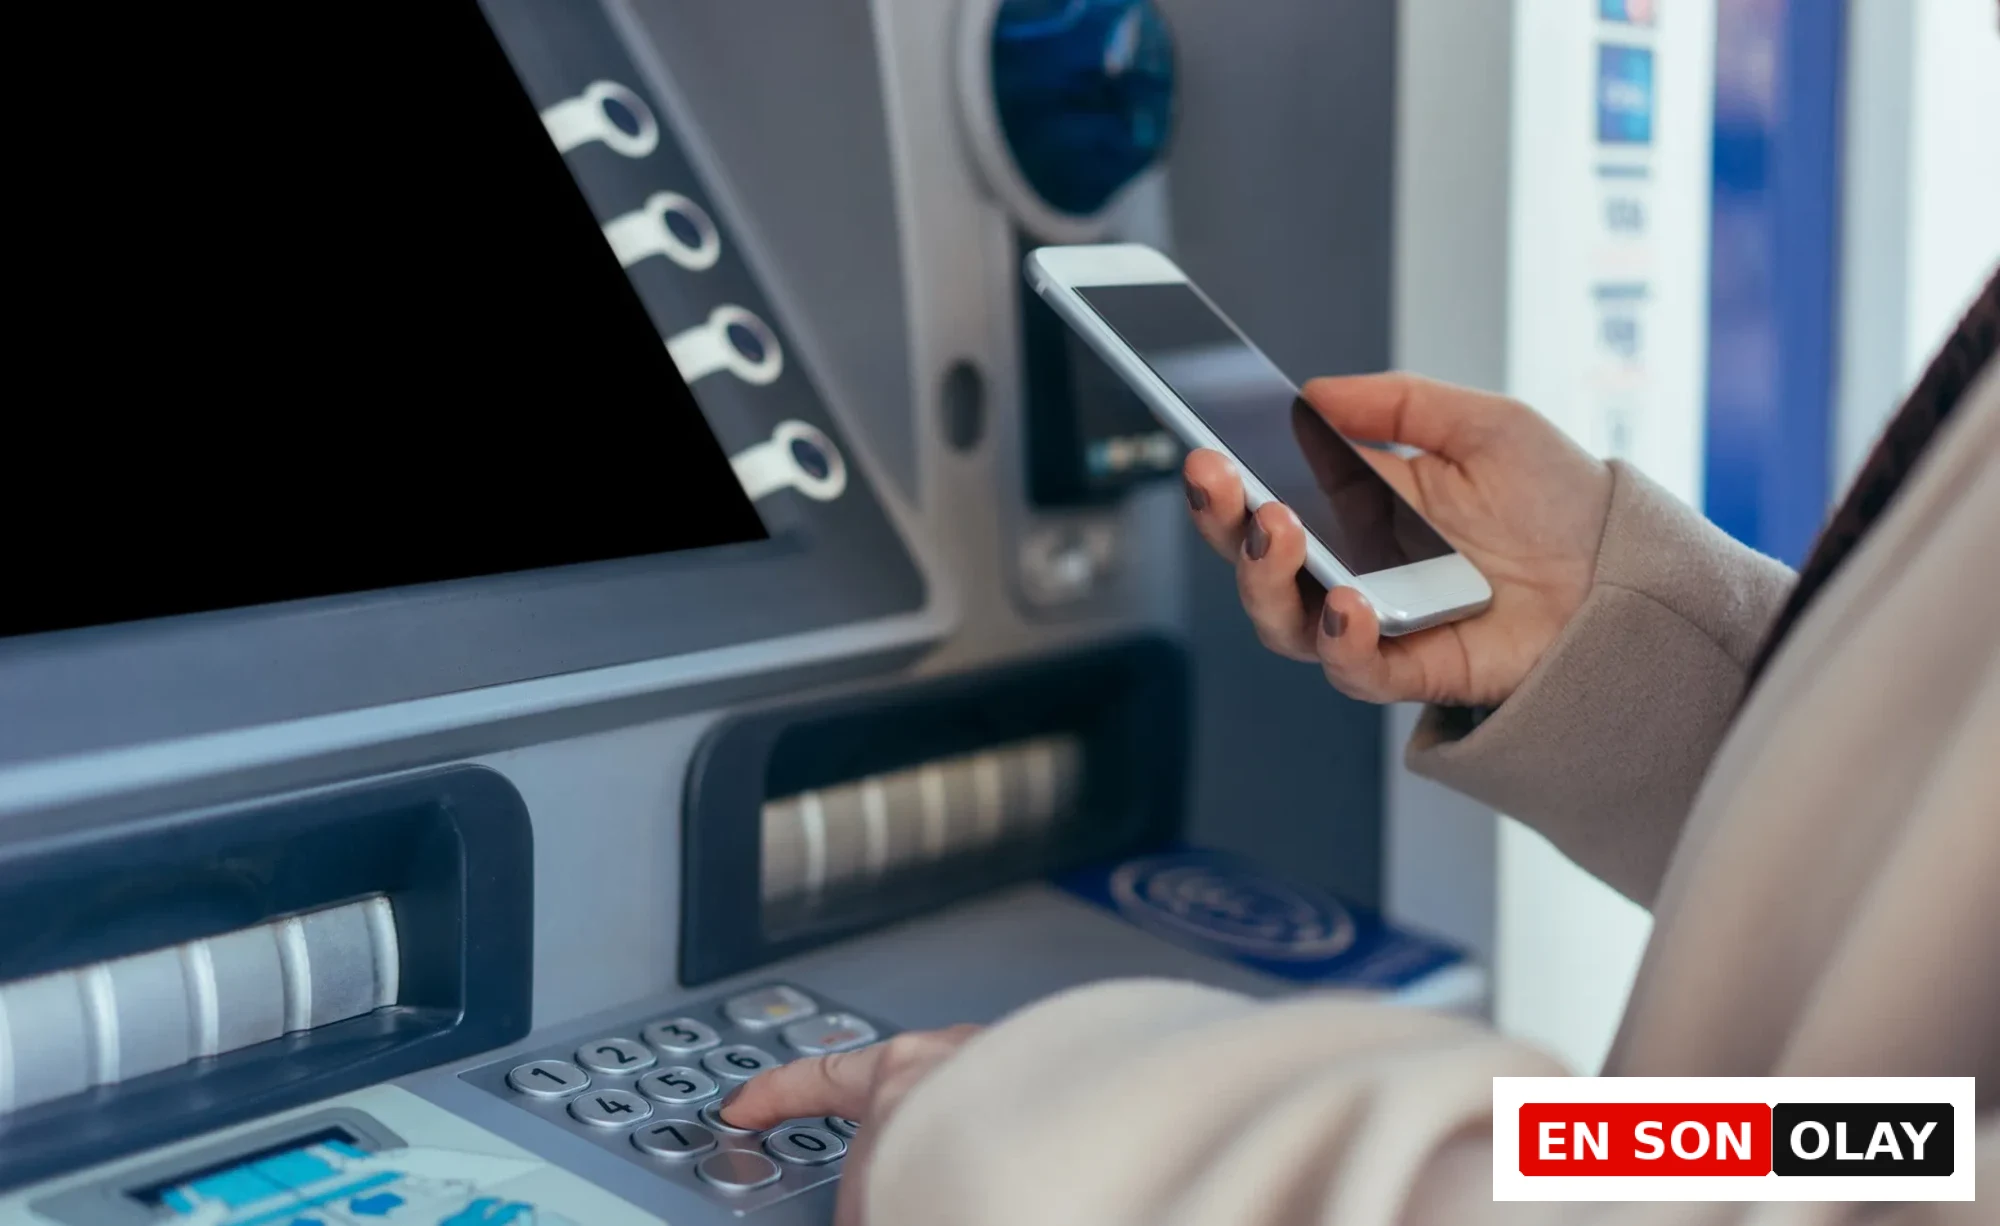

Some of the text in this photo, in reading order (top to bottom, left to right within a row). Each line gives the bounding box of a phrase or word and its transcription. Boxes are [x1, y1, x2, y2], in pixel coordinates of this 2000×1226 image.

[662, 1024, 699, 1043] 3
[597, 1045, 638, 1064] 2
[725, 1052, 760, 1070] 6
[531, 1067, 567, 1085] 1
[659, 1074, 697, 1094] 5
[595, 1097, 632, 1115] 4
[651, 1125, 690, 1146] 7
[788, 1133, 827, 1153] 0
